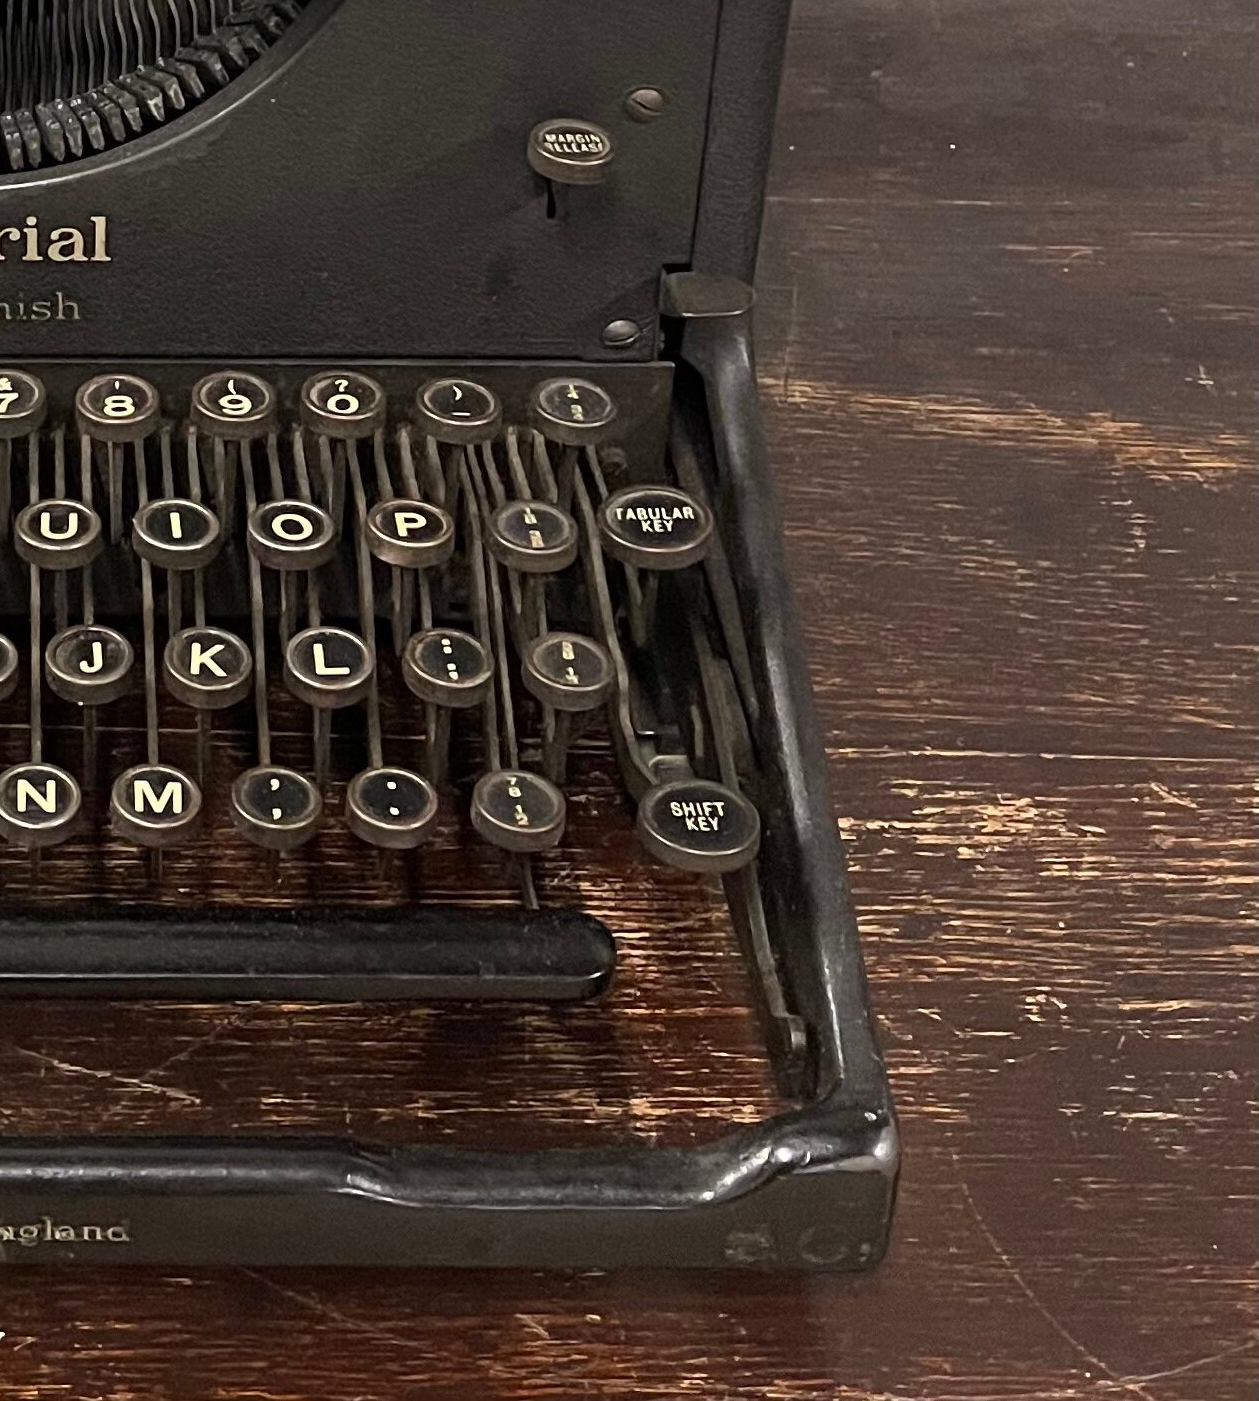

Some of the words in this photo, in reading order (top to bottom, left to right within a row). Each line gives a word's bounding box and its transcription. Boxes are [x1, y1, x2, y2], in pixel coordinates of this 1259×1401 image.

[334, 379, 349, 393] ?
[103, 395, 136, 417] 8
[215, 394, 253, 417] 9
[40, 511, 79, 540] U
[169, 511, 183, 539] I
[394, 512, 427, 537] P
[613, 504, 697, 521] TABULAR
[638, 517, 674, 533] KEY
[268, 513, 314, 543] O
[79, 641, 103, 674] J
[190, 642, 228, 677] K
[312, 643, 351, 676] L
[16, 778, 56, 813] N
[133, 778, 184, 815] M
[670, 801, 725, 820] SHIFT
[684, 813, 724, 832] KEY
